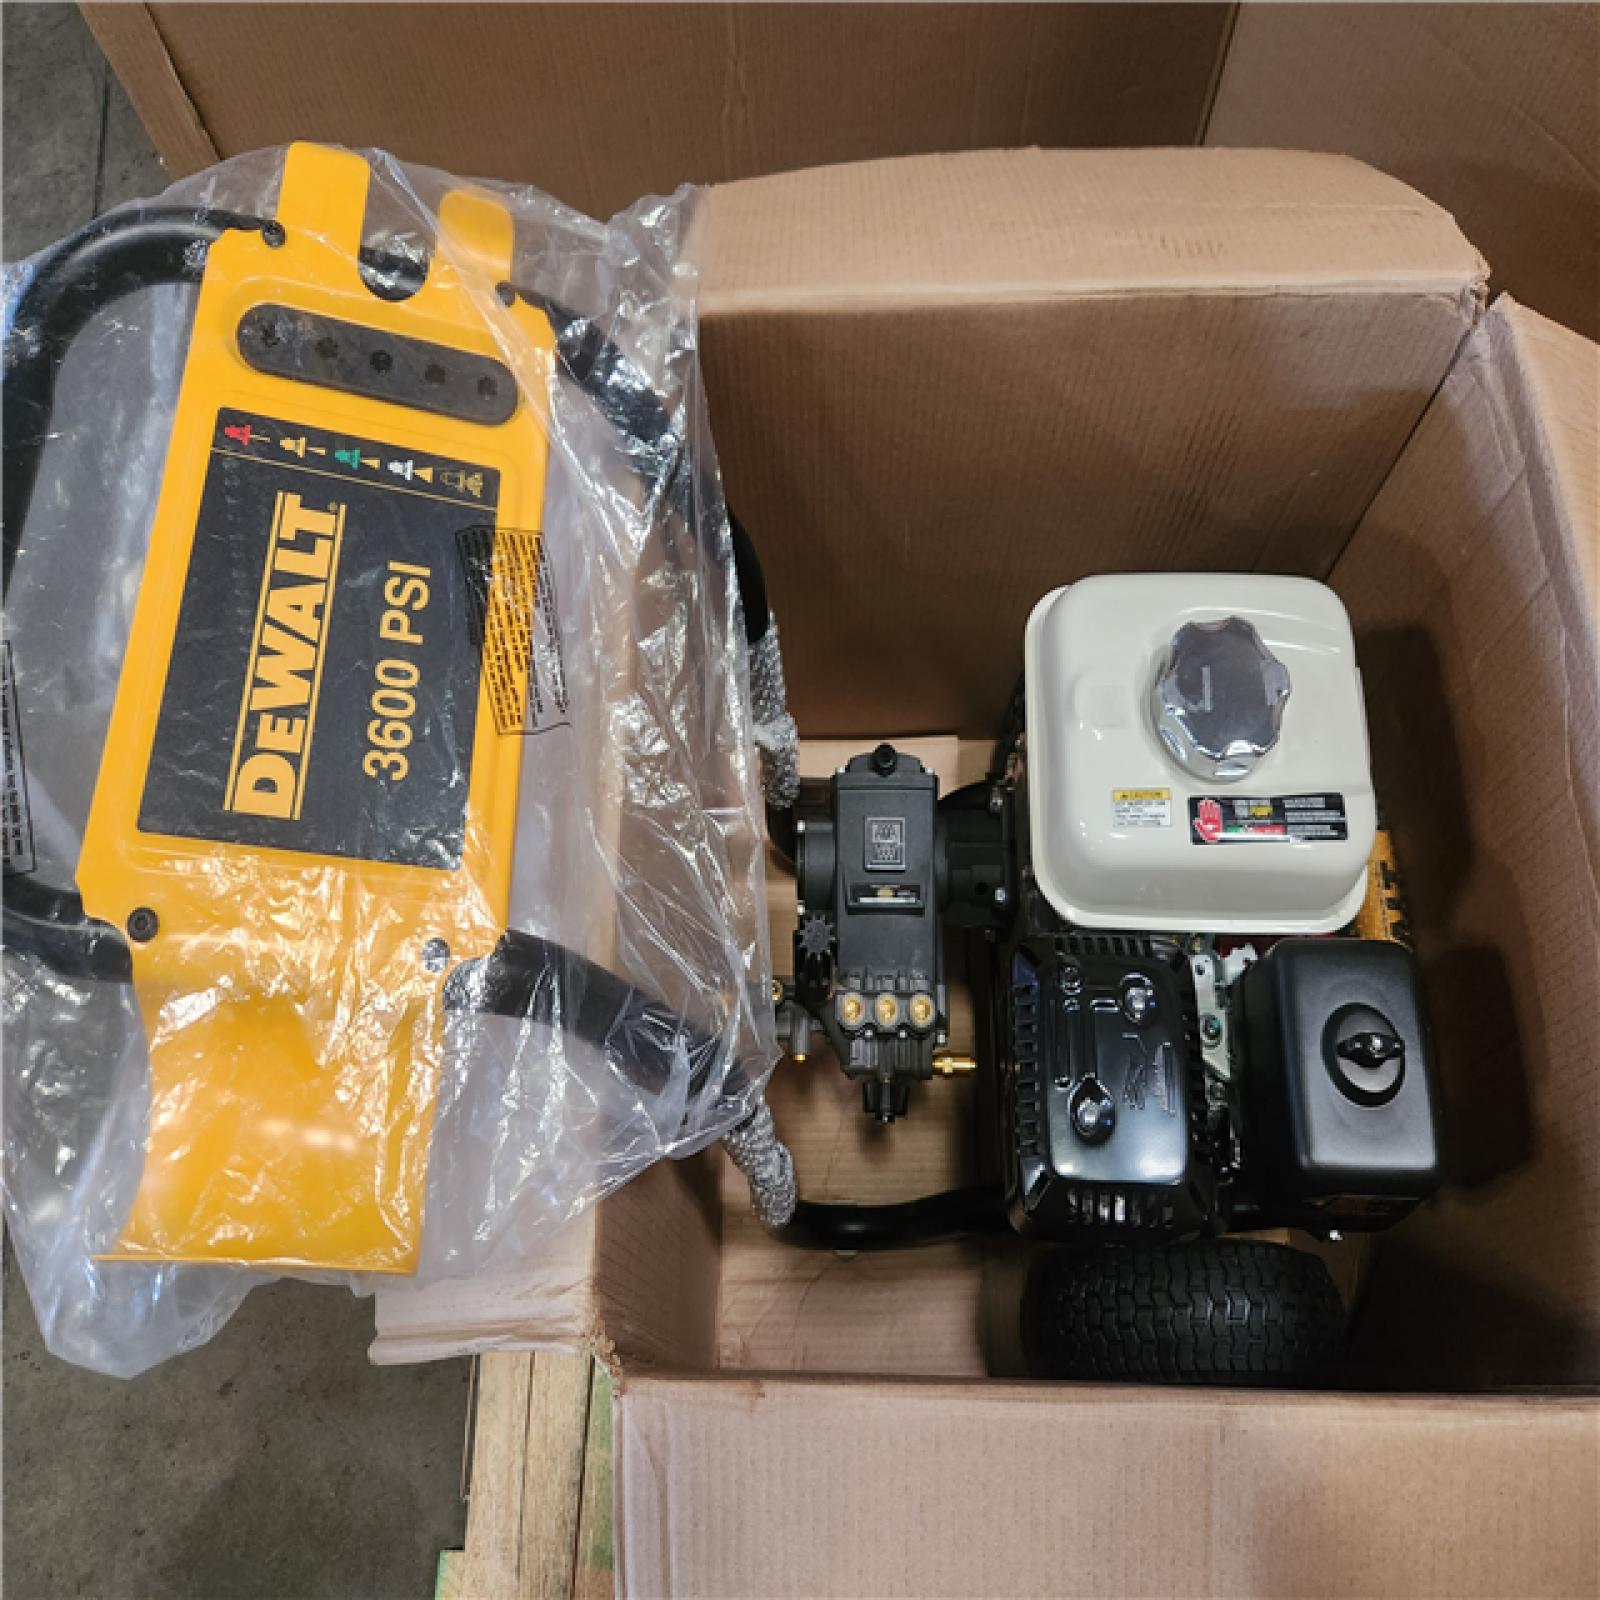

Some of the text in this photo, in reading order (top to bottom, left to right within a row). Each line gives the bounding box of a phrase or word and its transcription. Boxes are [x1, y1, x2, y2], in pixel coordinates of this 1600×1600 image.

[231, 491, 338, 819] DEWALT
[362, 559, 432, 782] 3600 PSI
